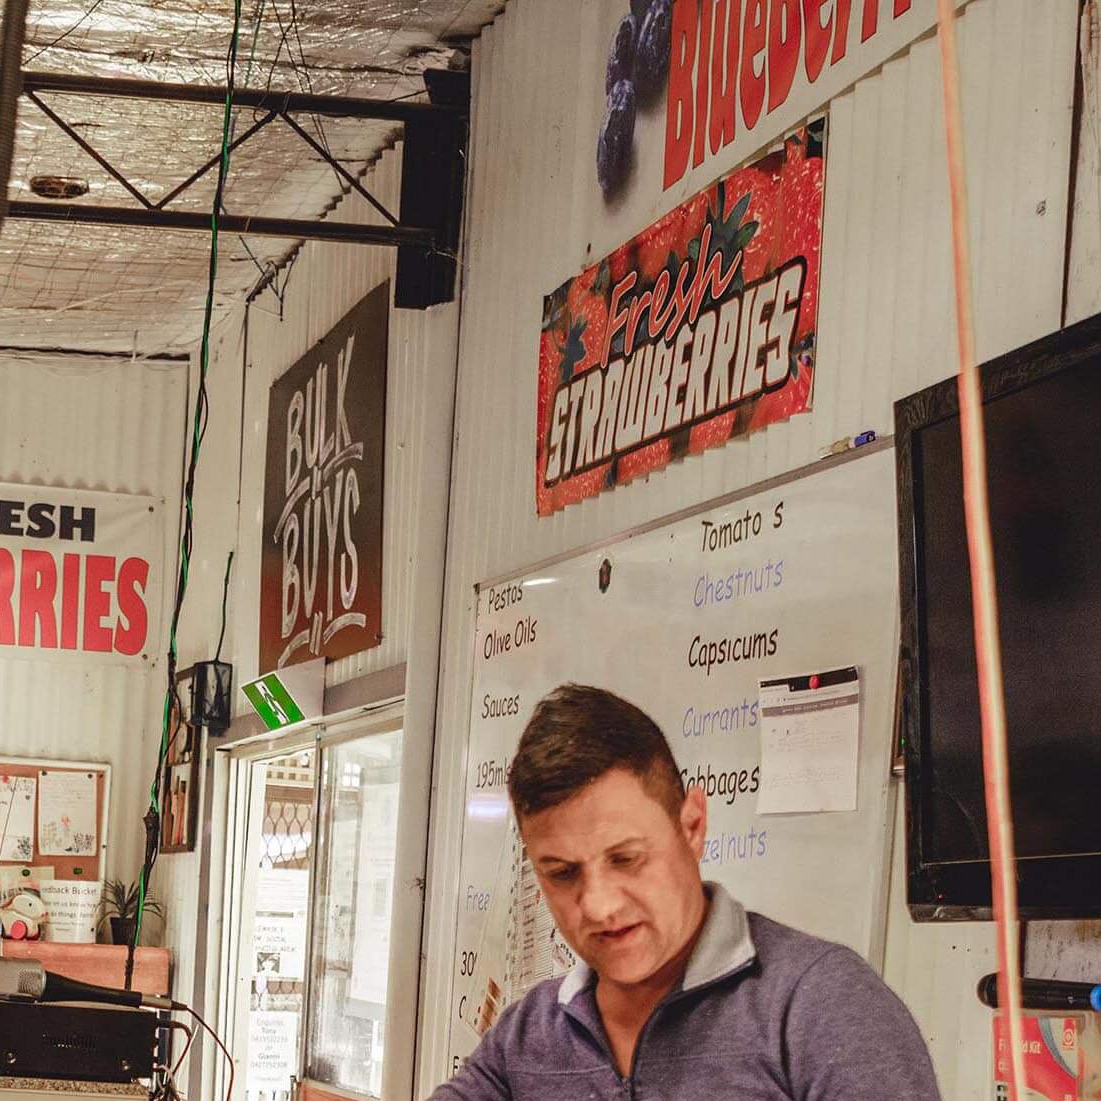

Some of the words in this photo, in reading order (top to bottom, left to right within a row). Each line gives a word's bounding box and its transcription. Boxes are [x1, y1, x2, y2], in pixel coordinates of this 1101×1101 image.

[600, 222, 743, 369] Fresh
[546, 262, 804, 482] STRAWBERRIES
[285, 334, 355, 497] BULK
[282, 466, 360, 639] BUYS
[701, 513, 762, 553] Tomato
[488, 579, 524, 614] Pestos
[693, 560, 784, 608] Chestnuts
[483, 631, 511, 660] Olive
[514, 615, 538, 648] Oils
[688, 628, 779, 677] Capsicums
[481, 692, 520, 720] Sauces
[682, 697, 759, 738] Currants
[466, 884, 491, 912] Free
